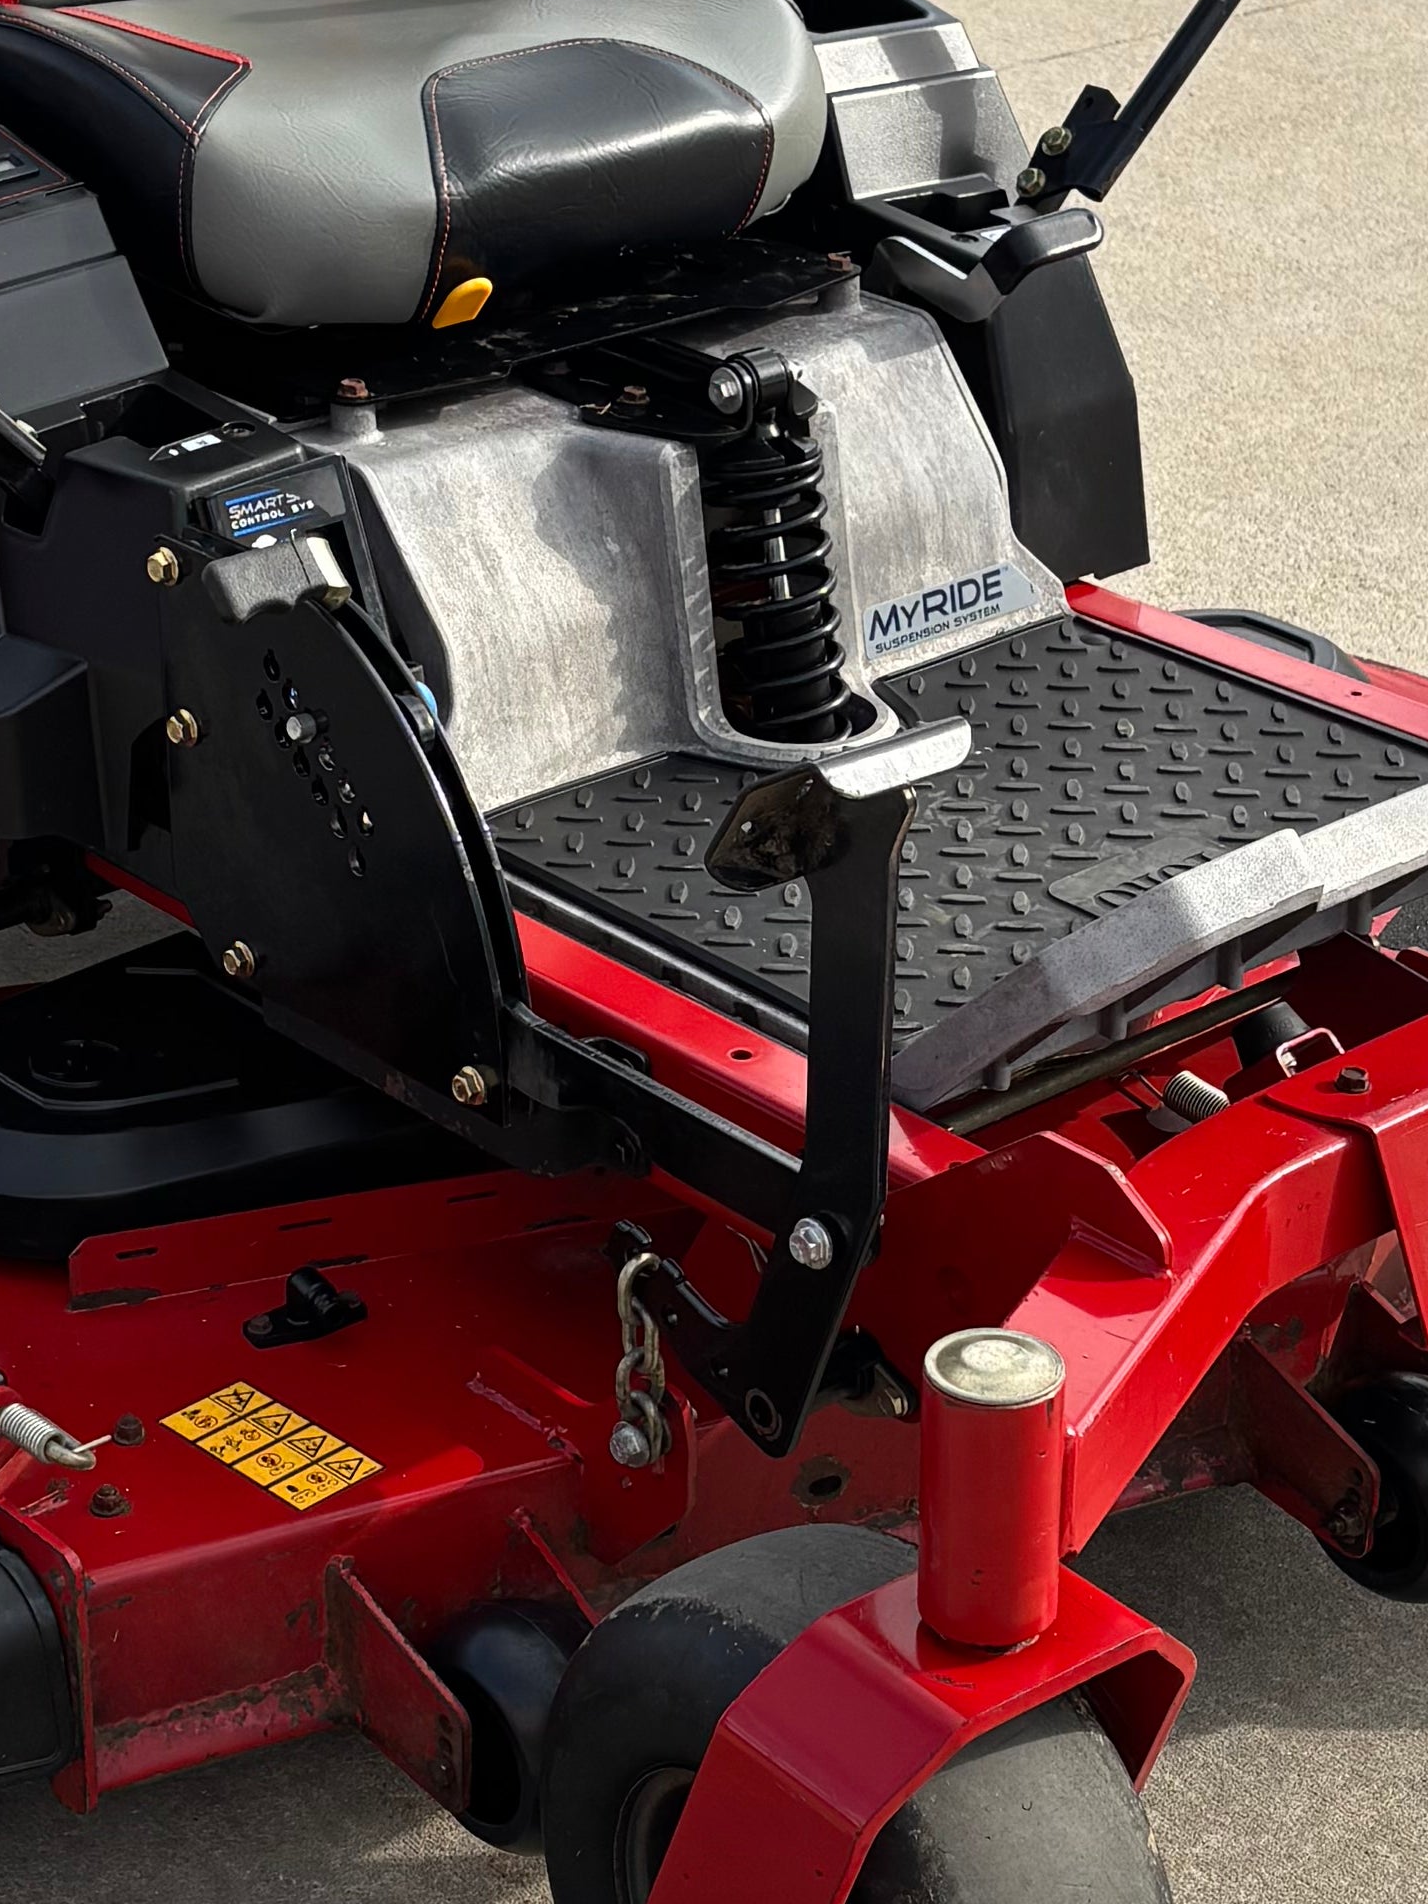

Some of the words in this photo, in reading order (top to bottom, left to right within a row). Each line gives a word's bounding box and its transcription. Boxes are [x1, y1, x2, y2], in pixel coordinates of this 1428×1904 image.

[231, 509, 285, 530] CONTROL
[290, 499, 315, 514] SYS
[875, 621, 950, 654] SUSPENSION
[954, 603, 1001, 627] SYSTEM
